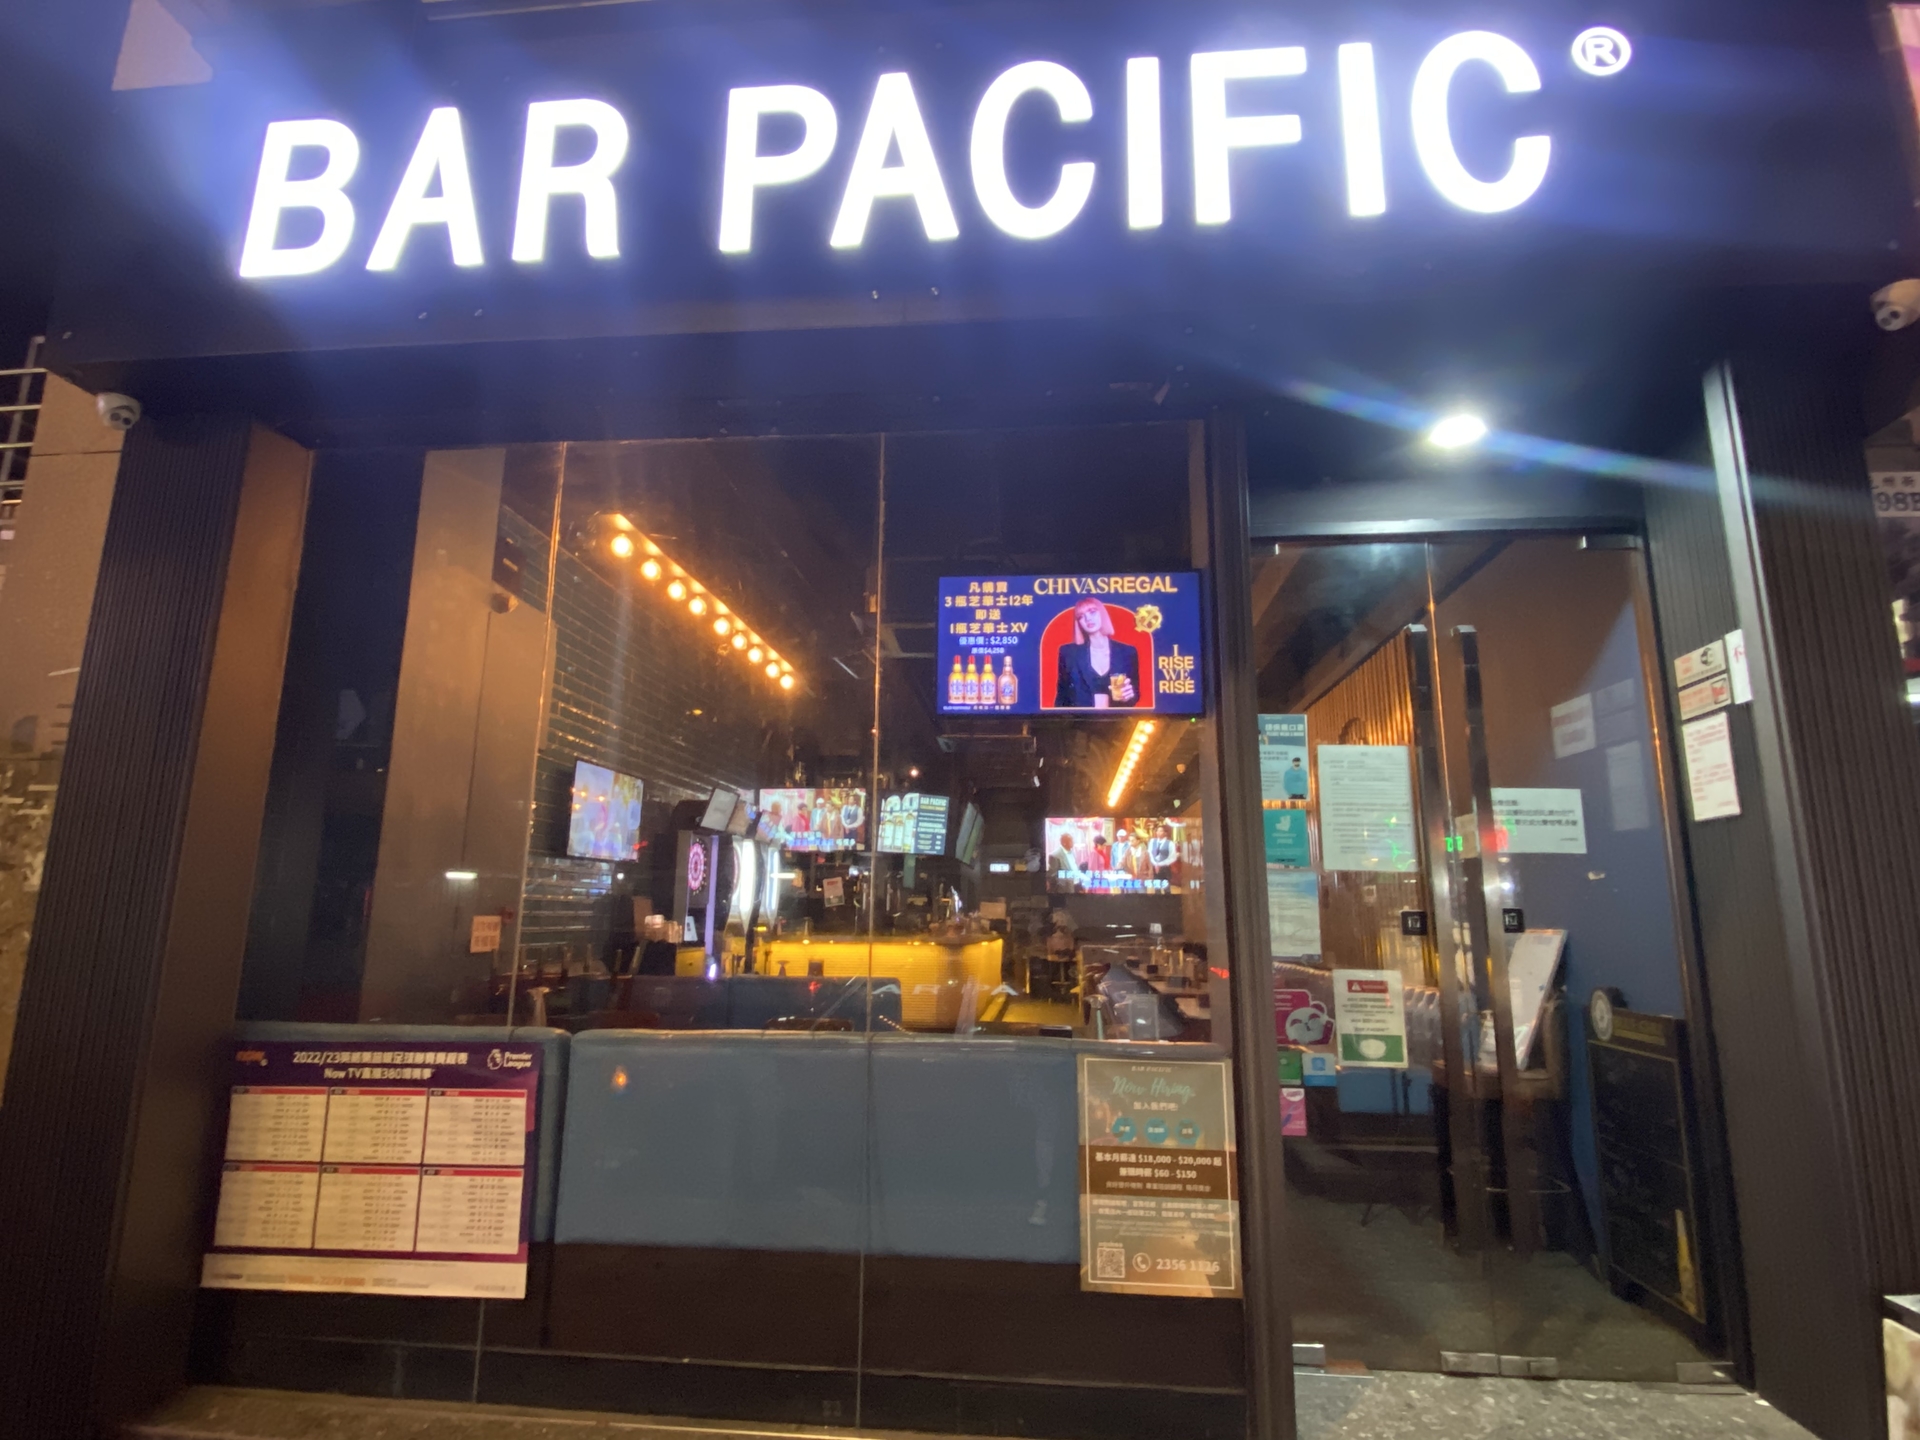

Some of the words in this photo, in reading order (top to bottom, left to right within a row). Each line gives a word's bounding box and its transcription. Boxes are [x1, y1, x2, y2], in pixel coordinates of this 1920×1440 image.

[238, 97, 631, 279] BAR
[718, 29, 1553, 254] PACIFIC
[944, 596, 952, 607] 3
[975, 609, 1001, 620] 即送
[1010, 622, 1028, 633] XV
[990, 636, 1018, 645] $2,850
[1172, 644, 1179, 656] I
[1158, 656, 1194, 669] RISE
[1161, 668, 1190, 681] WE
[1159, 680, 1195, 693] RISE
[323, 1067, 347, 1079] Now
[1112, 1075, 1146, 1097] Now
[1138, 1153, 1172, 1165] $18,000
[1154, 1168, 1170, 1178] $60
[1176, 1169, 1197, 1179] $150
[1156, 1258, 1187, 1271] 2356
